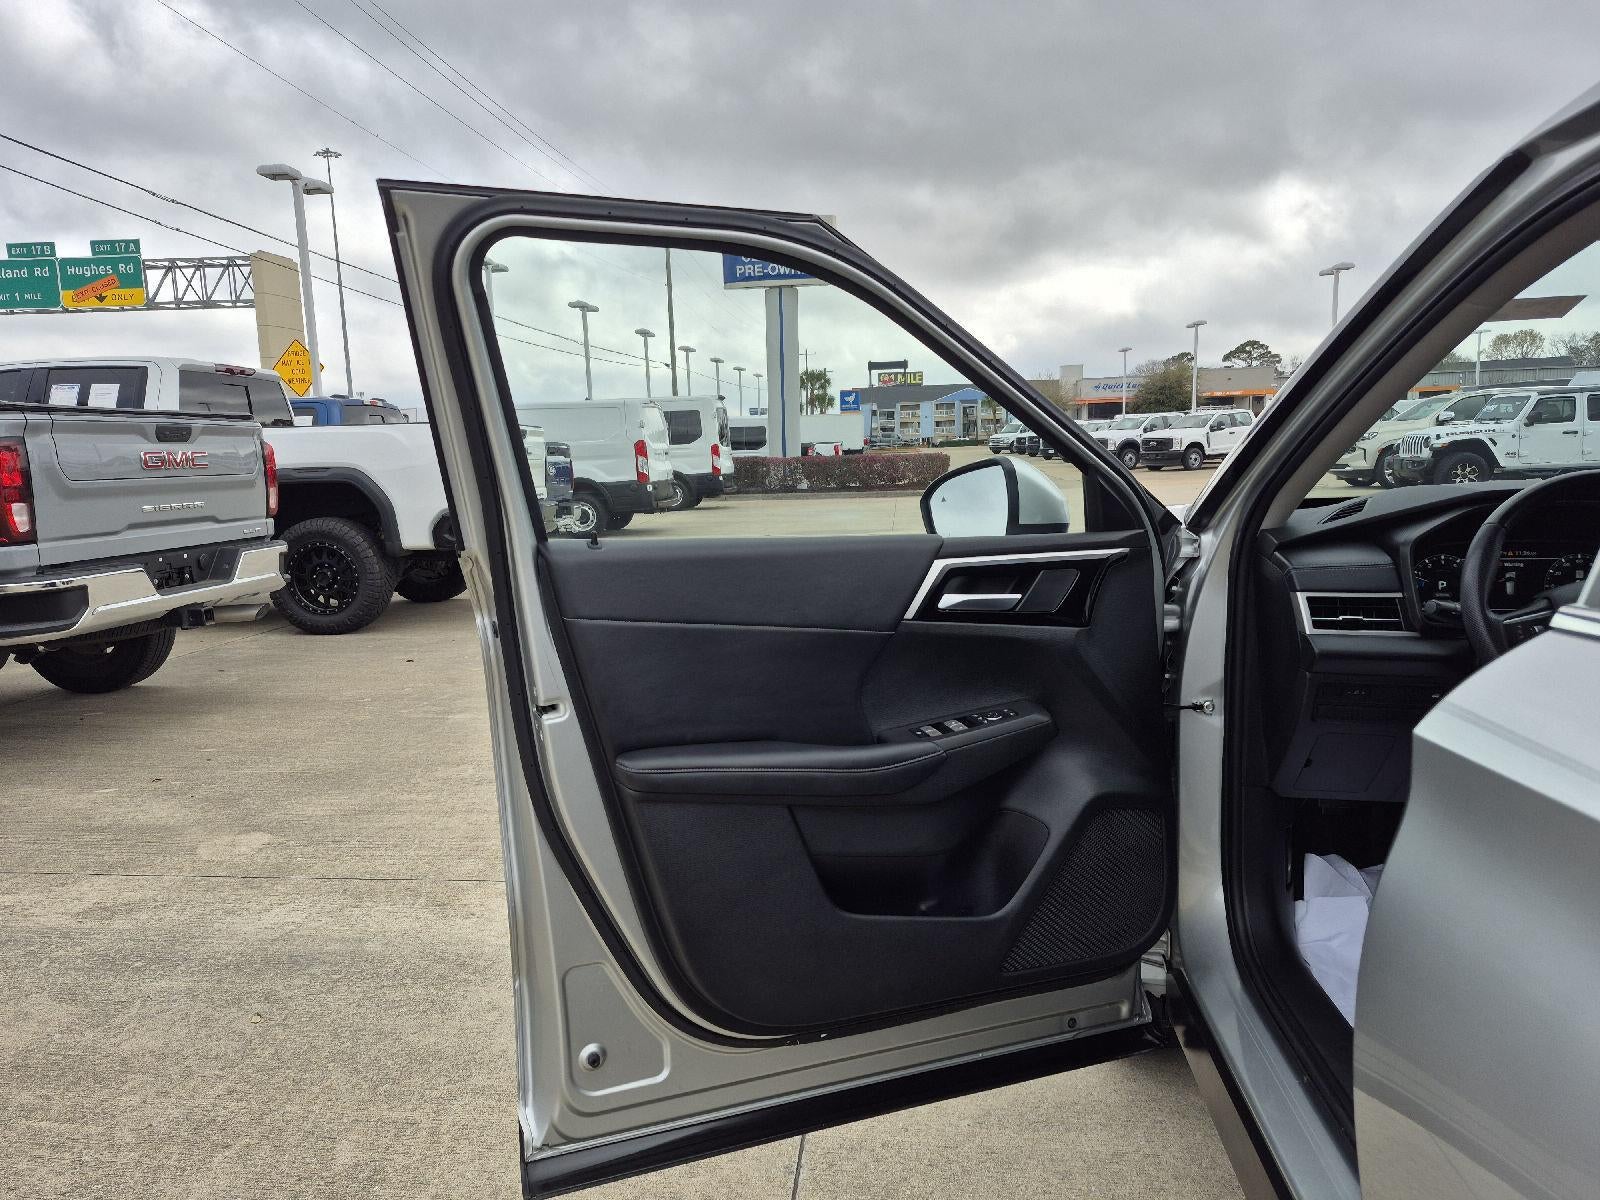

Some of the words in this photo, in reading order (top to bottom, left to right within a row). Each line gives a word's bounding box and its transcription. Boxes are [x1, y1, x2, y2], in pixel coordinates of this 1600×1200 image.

[11, 247, 27, 255] EXIT
[95, 244, 111, 252] EXIT
[0, 267, 28, 279] land
[34, 266, 49, 277] Rd
[67, 264, 113, 277] Hughes
[119, 263, 134, 274] Rd
[14, 292, 20, 302] 1
[111, 293, 135, 301] ONLY
[141, 451, 209, 471] GMC
[142, 501, 205, 513] SIERRA
[1438, 580, 1447, 591] P
